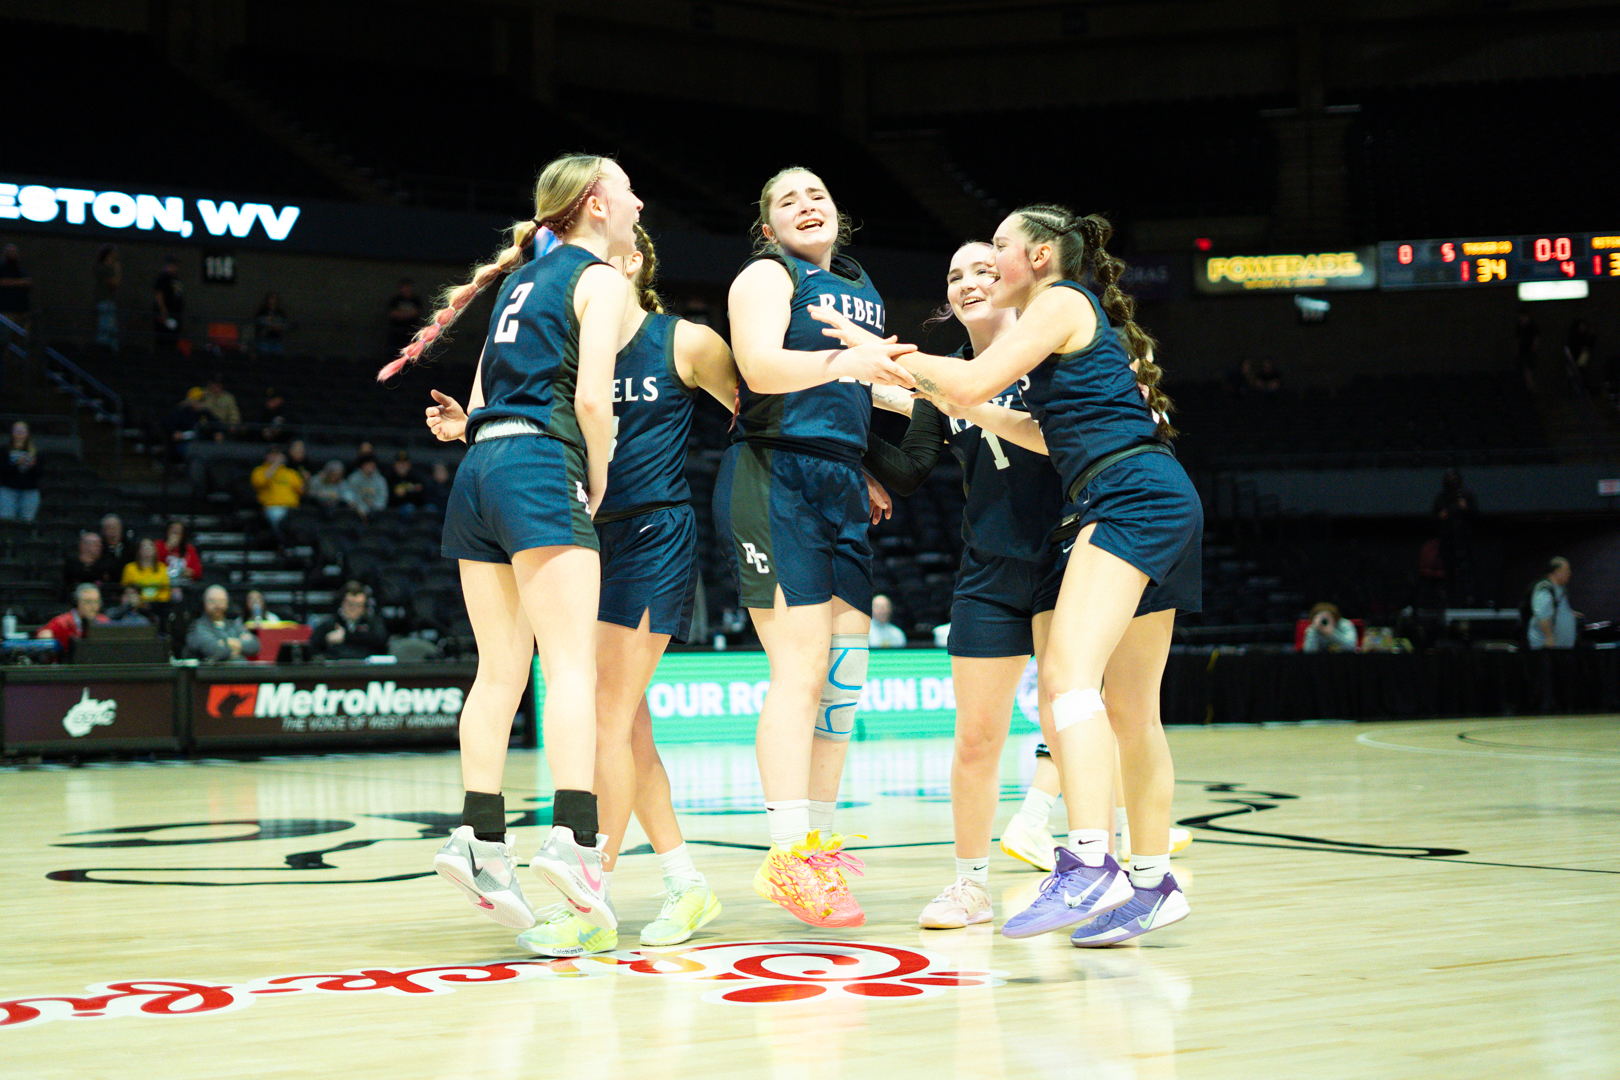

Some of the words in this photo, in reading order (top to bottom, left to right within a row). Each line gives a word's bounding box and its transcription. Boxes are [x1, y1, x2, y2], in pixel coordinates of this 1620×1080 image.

[197, 199, 300, 241] WV
[1476, 258, 1507, 283] 34
[1560, 261, 1576, 277] 4
[494, 282, 534, 343] 2
[818, 293, 886, 334] REBEL
[254, 680, 464, 718] MetroNews
[648, 682, 726, 718] OUR
[281, 717, 307, 732] THE
[309, 716, 347, 731] VOICE
[349, 715, 366, 731] OF
[368, 715, 404, 730] WEST
